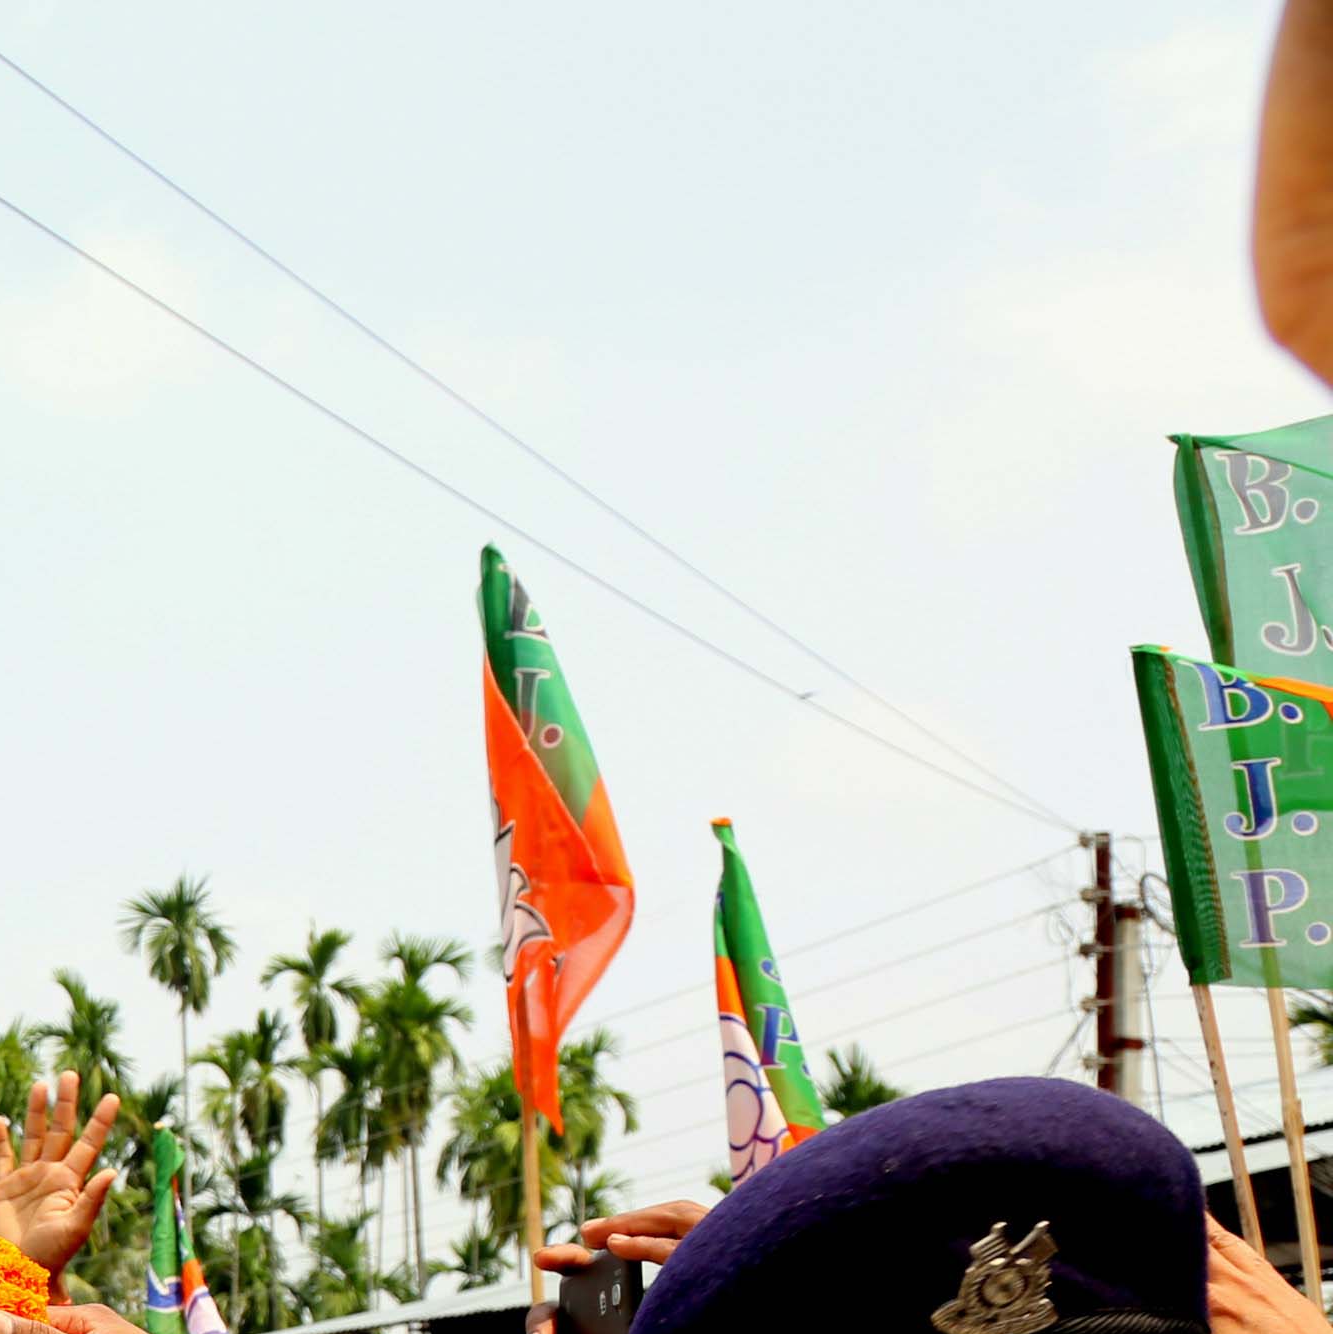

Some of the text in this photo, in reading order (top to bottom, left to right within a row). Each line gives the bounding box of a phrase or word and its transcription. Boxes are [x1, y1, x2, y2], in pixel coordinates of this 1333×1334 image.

[1213, 450, 1319, 536] B.
[1177, 658, 1304, 732] B.
[1223, 757, 1319, 841] J.
[1230, 867, 1332, 948] P.
